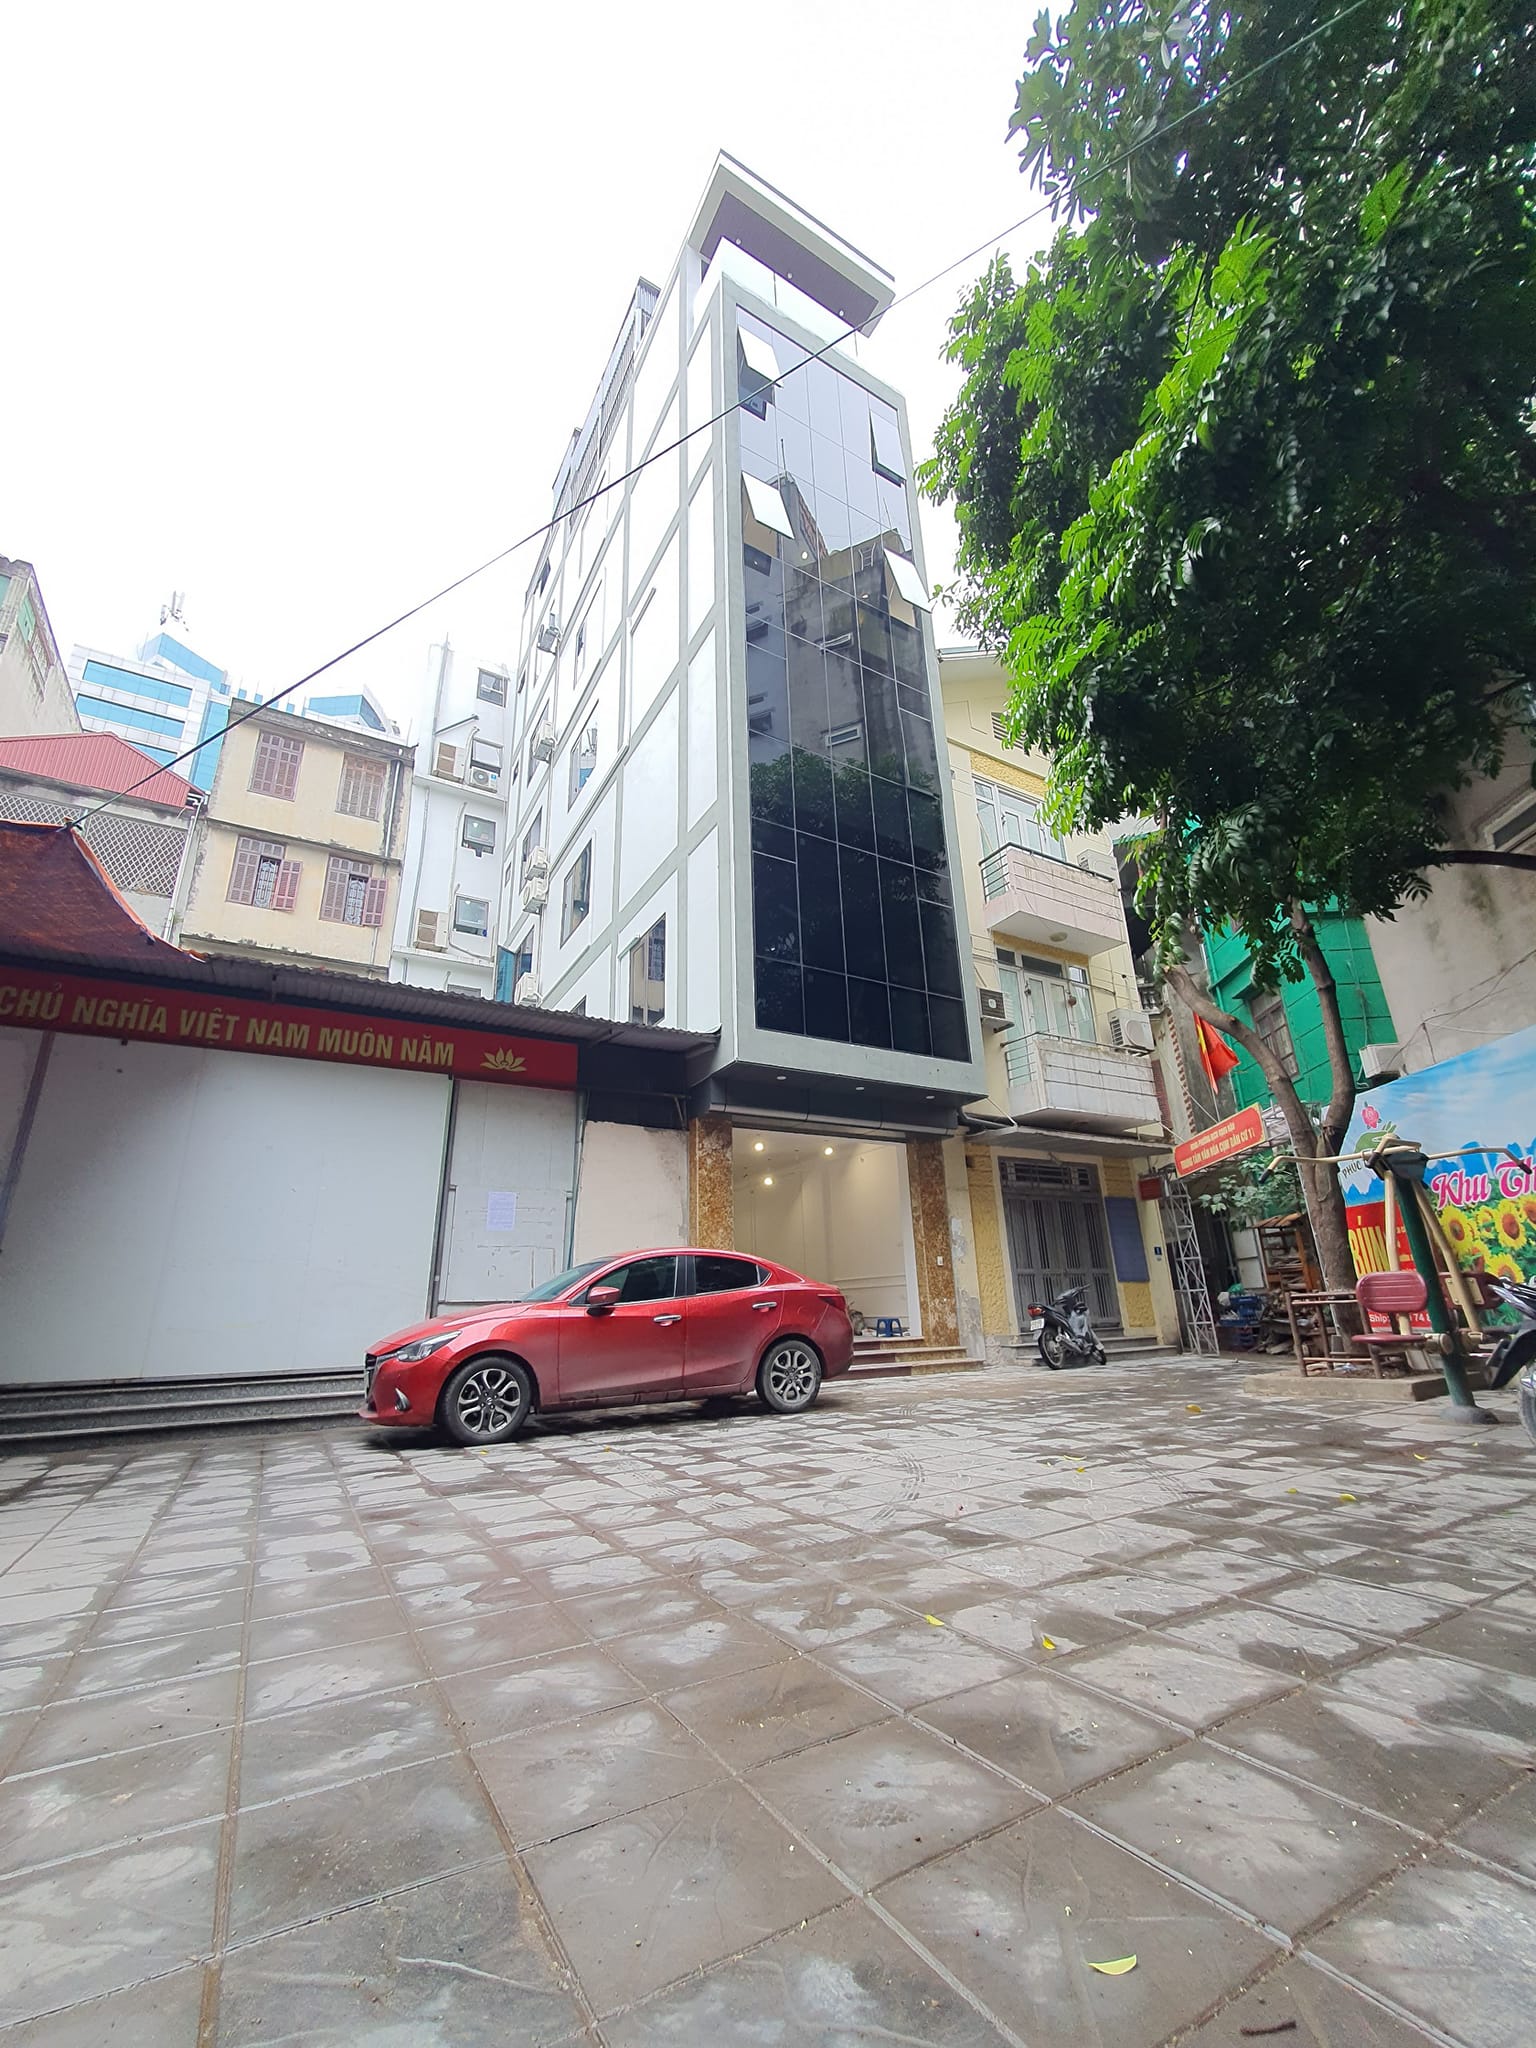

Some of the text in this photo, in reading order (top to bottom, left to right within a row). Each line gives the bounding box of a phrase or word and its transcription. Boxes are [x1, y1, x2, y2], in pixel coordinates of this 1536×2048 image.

[0, 983, 454, 1066] CHỦ NGHĨA VIỆT NAM MUÔN NĂM
[1432, 1169, 1490, 1210] Khu
